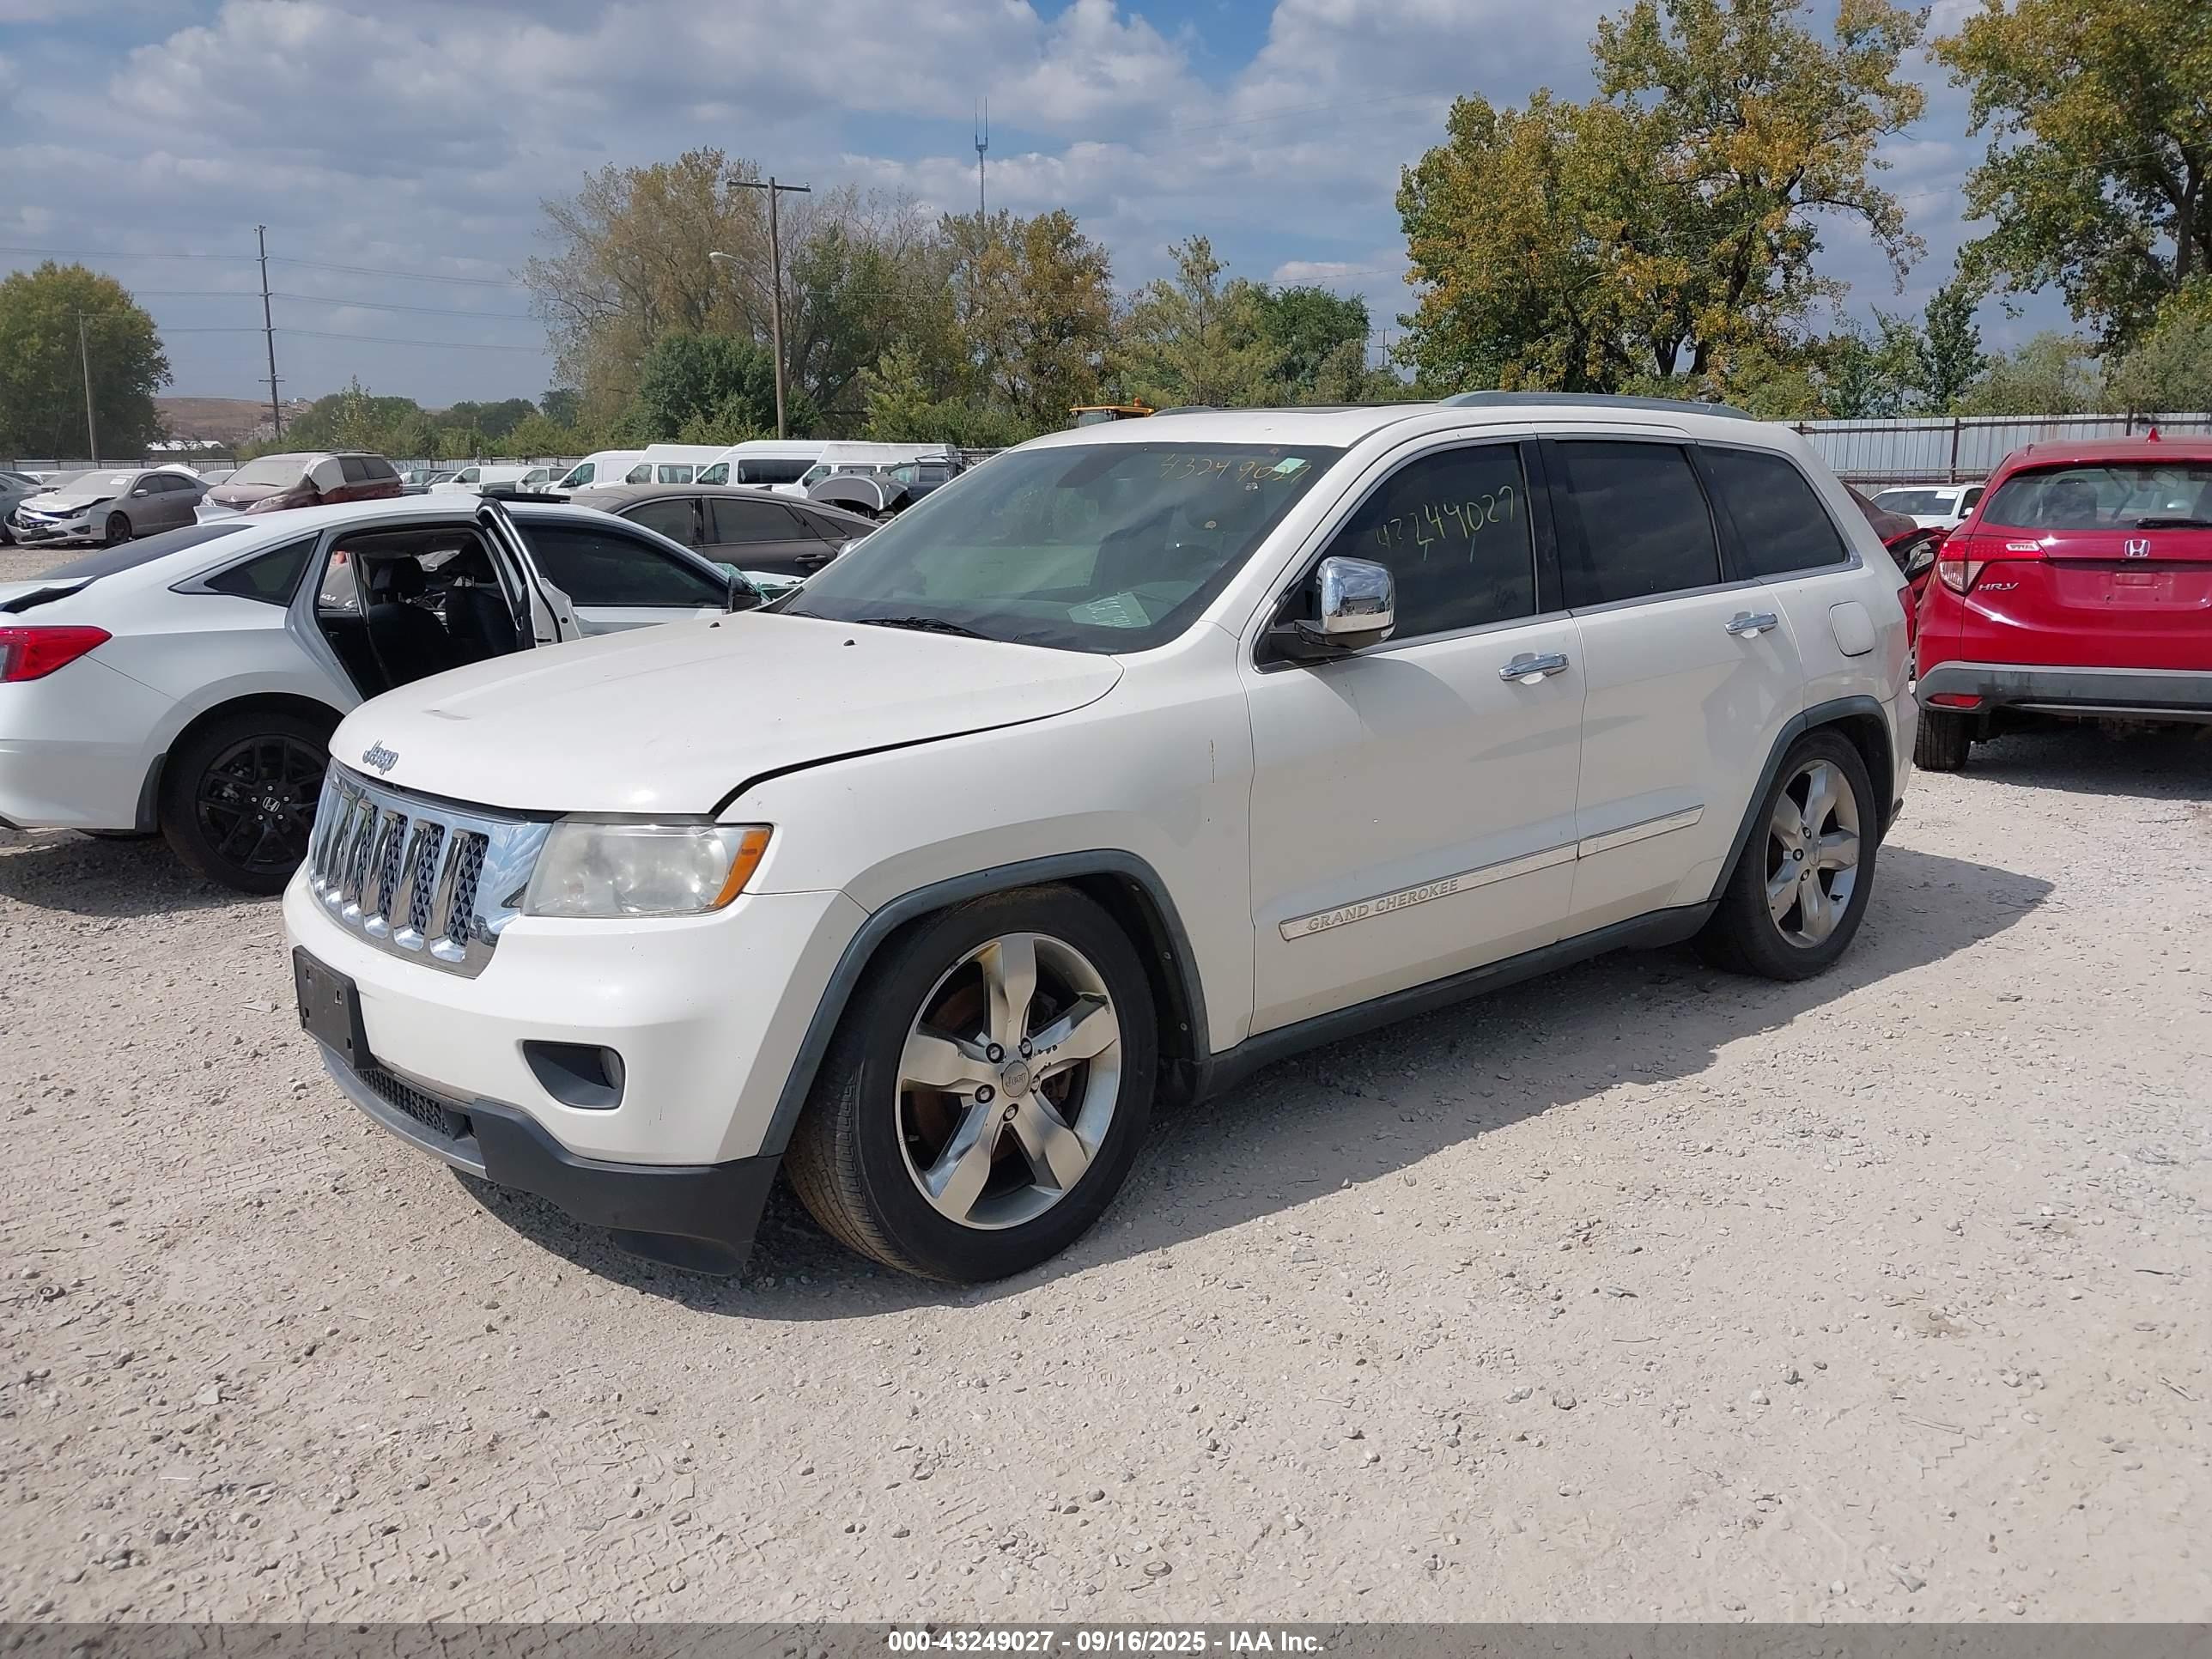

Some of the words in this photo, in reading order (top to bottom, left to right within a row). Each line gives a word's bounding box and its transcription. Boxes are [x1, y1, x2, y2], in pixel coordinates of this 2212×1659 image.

[362, 739, 398, 775] Jeep
[1307, 904, 1369, 931] GRAND
[1375, 879, 1458, 913] CHEROKEE
